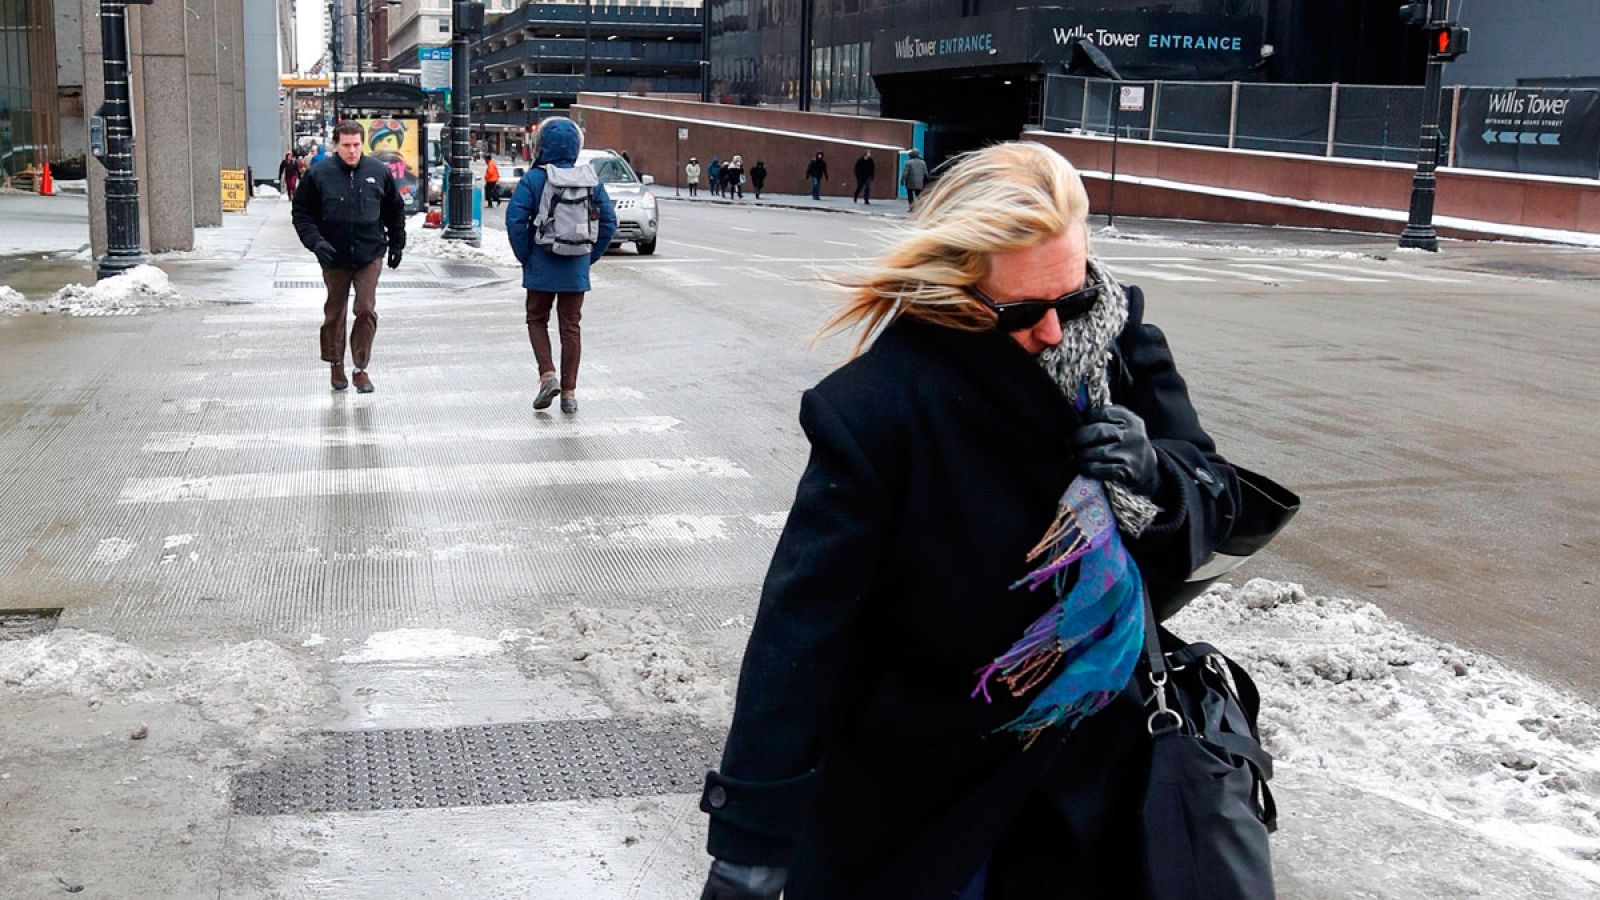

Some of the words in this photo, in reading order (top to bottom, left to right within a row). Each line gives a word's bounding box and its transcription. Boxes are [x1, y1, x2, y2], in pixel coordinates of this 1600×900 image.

[914, 39, 937, 57] Tower
[940, 33, 992, 54] ENTRANCE
[1096, 29, 1141, 48] Tower
[1149, 34, 1241, 50] ENTRANCE
[1489, 90, 1524, 113] Willis
[1527, 95, 1570, 115] Tower
